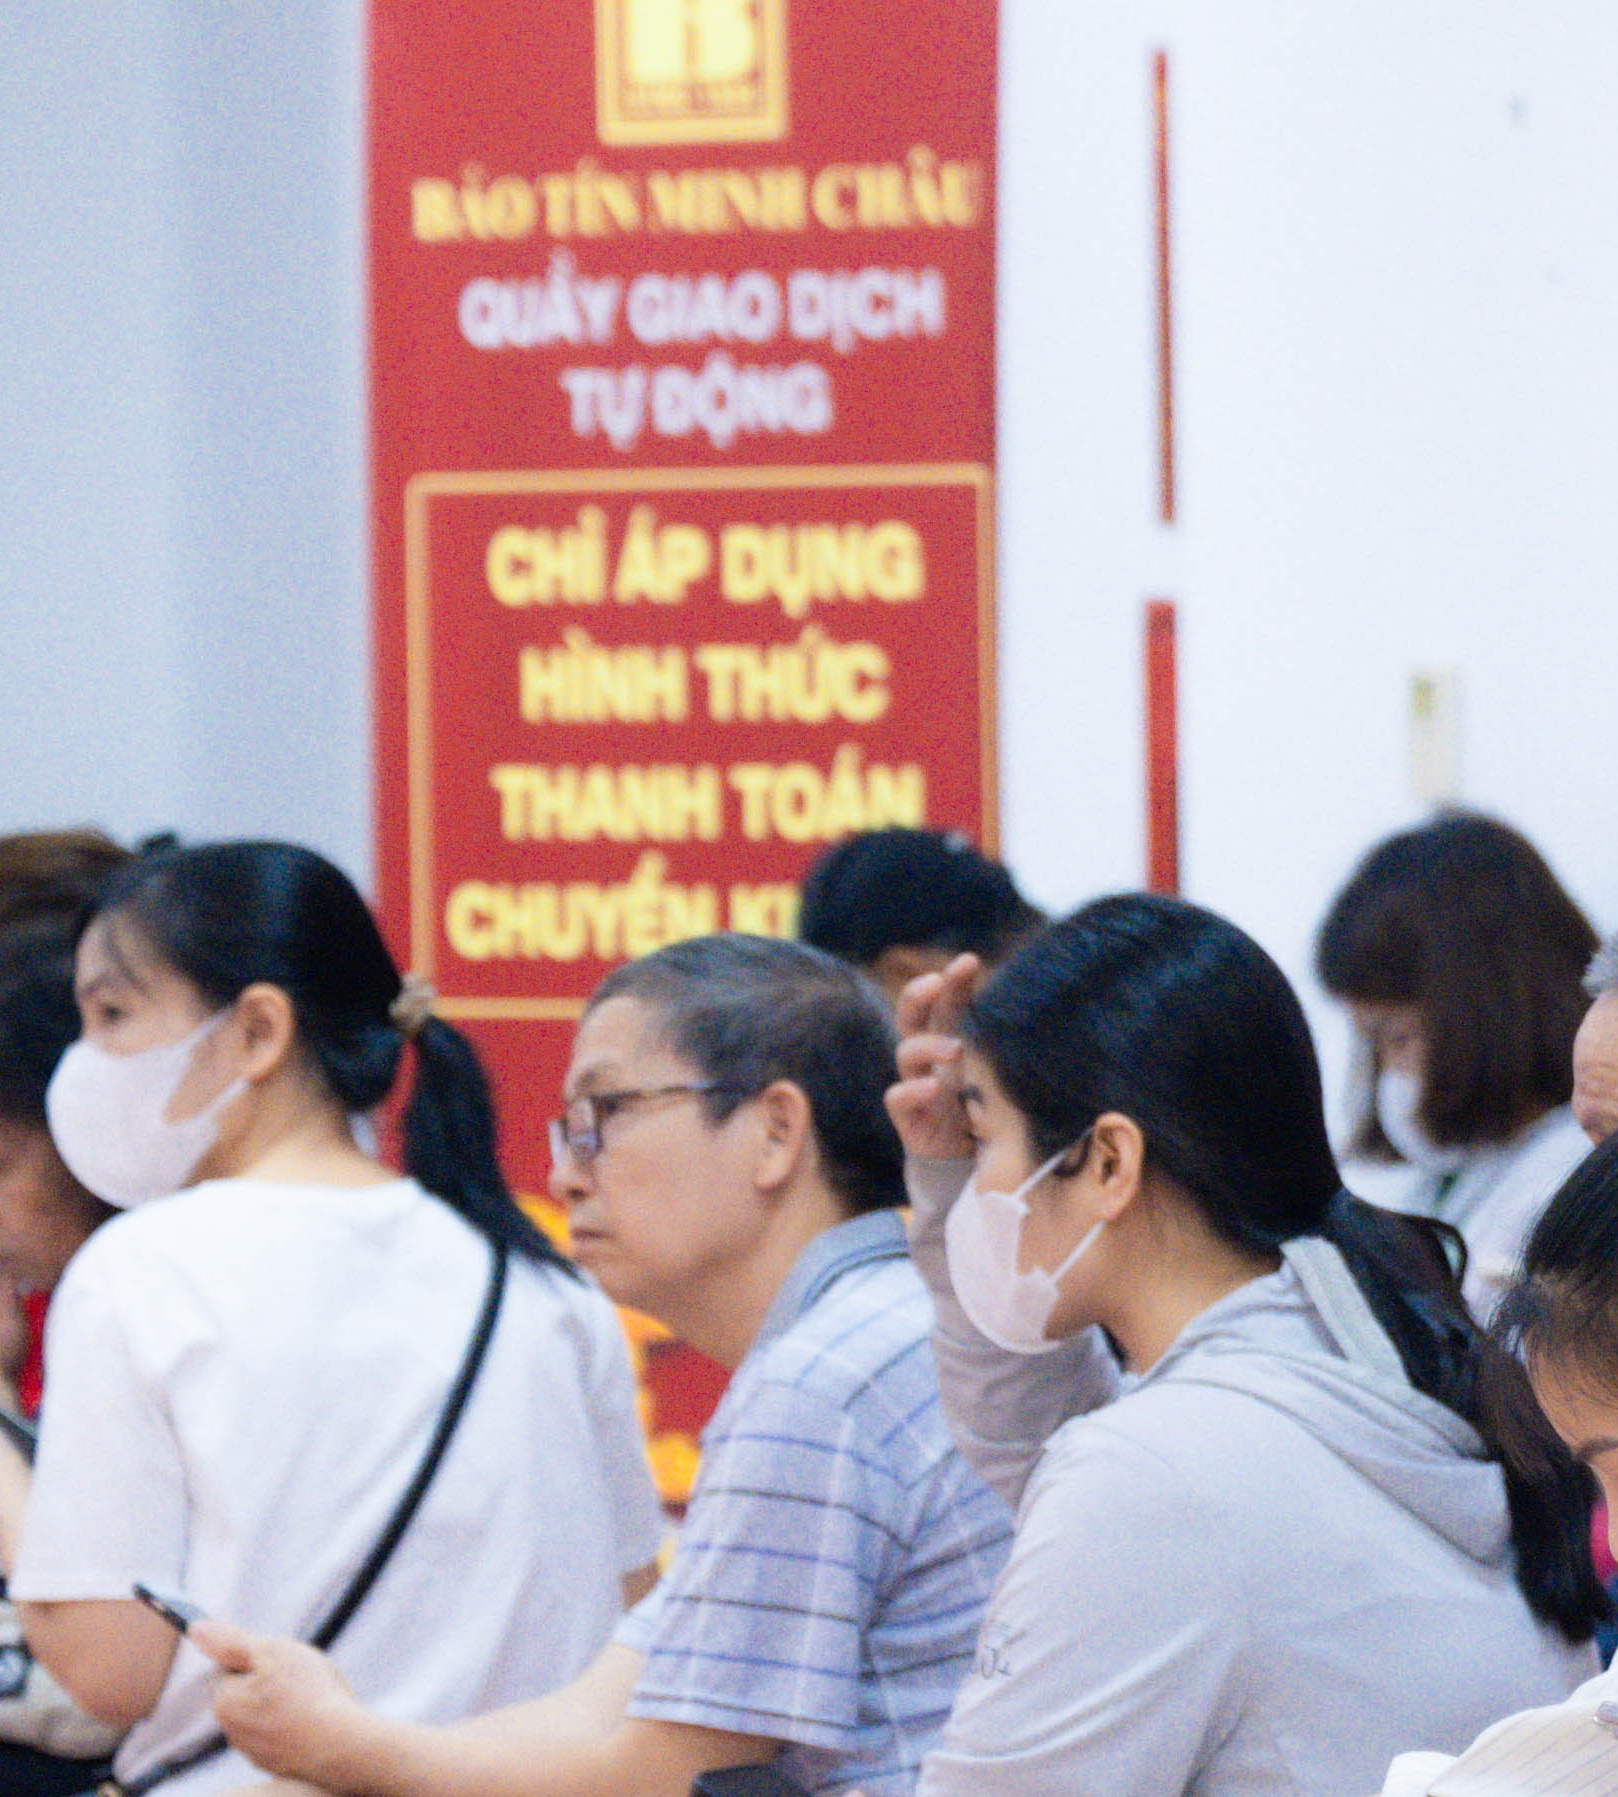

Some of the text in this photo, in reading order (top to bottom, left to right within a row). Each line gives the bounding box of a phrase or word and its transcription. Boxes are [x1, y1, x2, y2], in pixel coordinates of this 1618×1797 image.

[626, 270, 781, 345] GIAO
[786, 265, 946, 356] DỊCH
[487, 504, 926, 619] CHỈ ÁP DỤNG
[519, 623, 891, 724] HÌNH THỨC
[489, 742, 927, 843] THANH TOÁN
